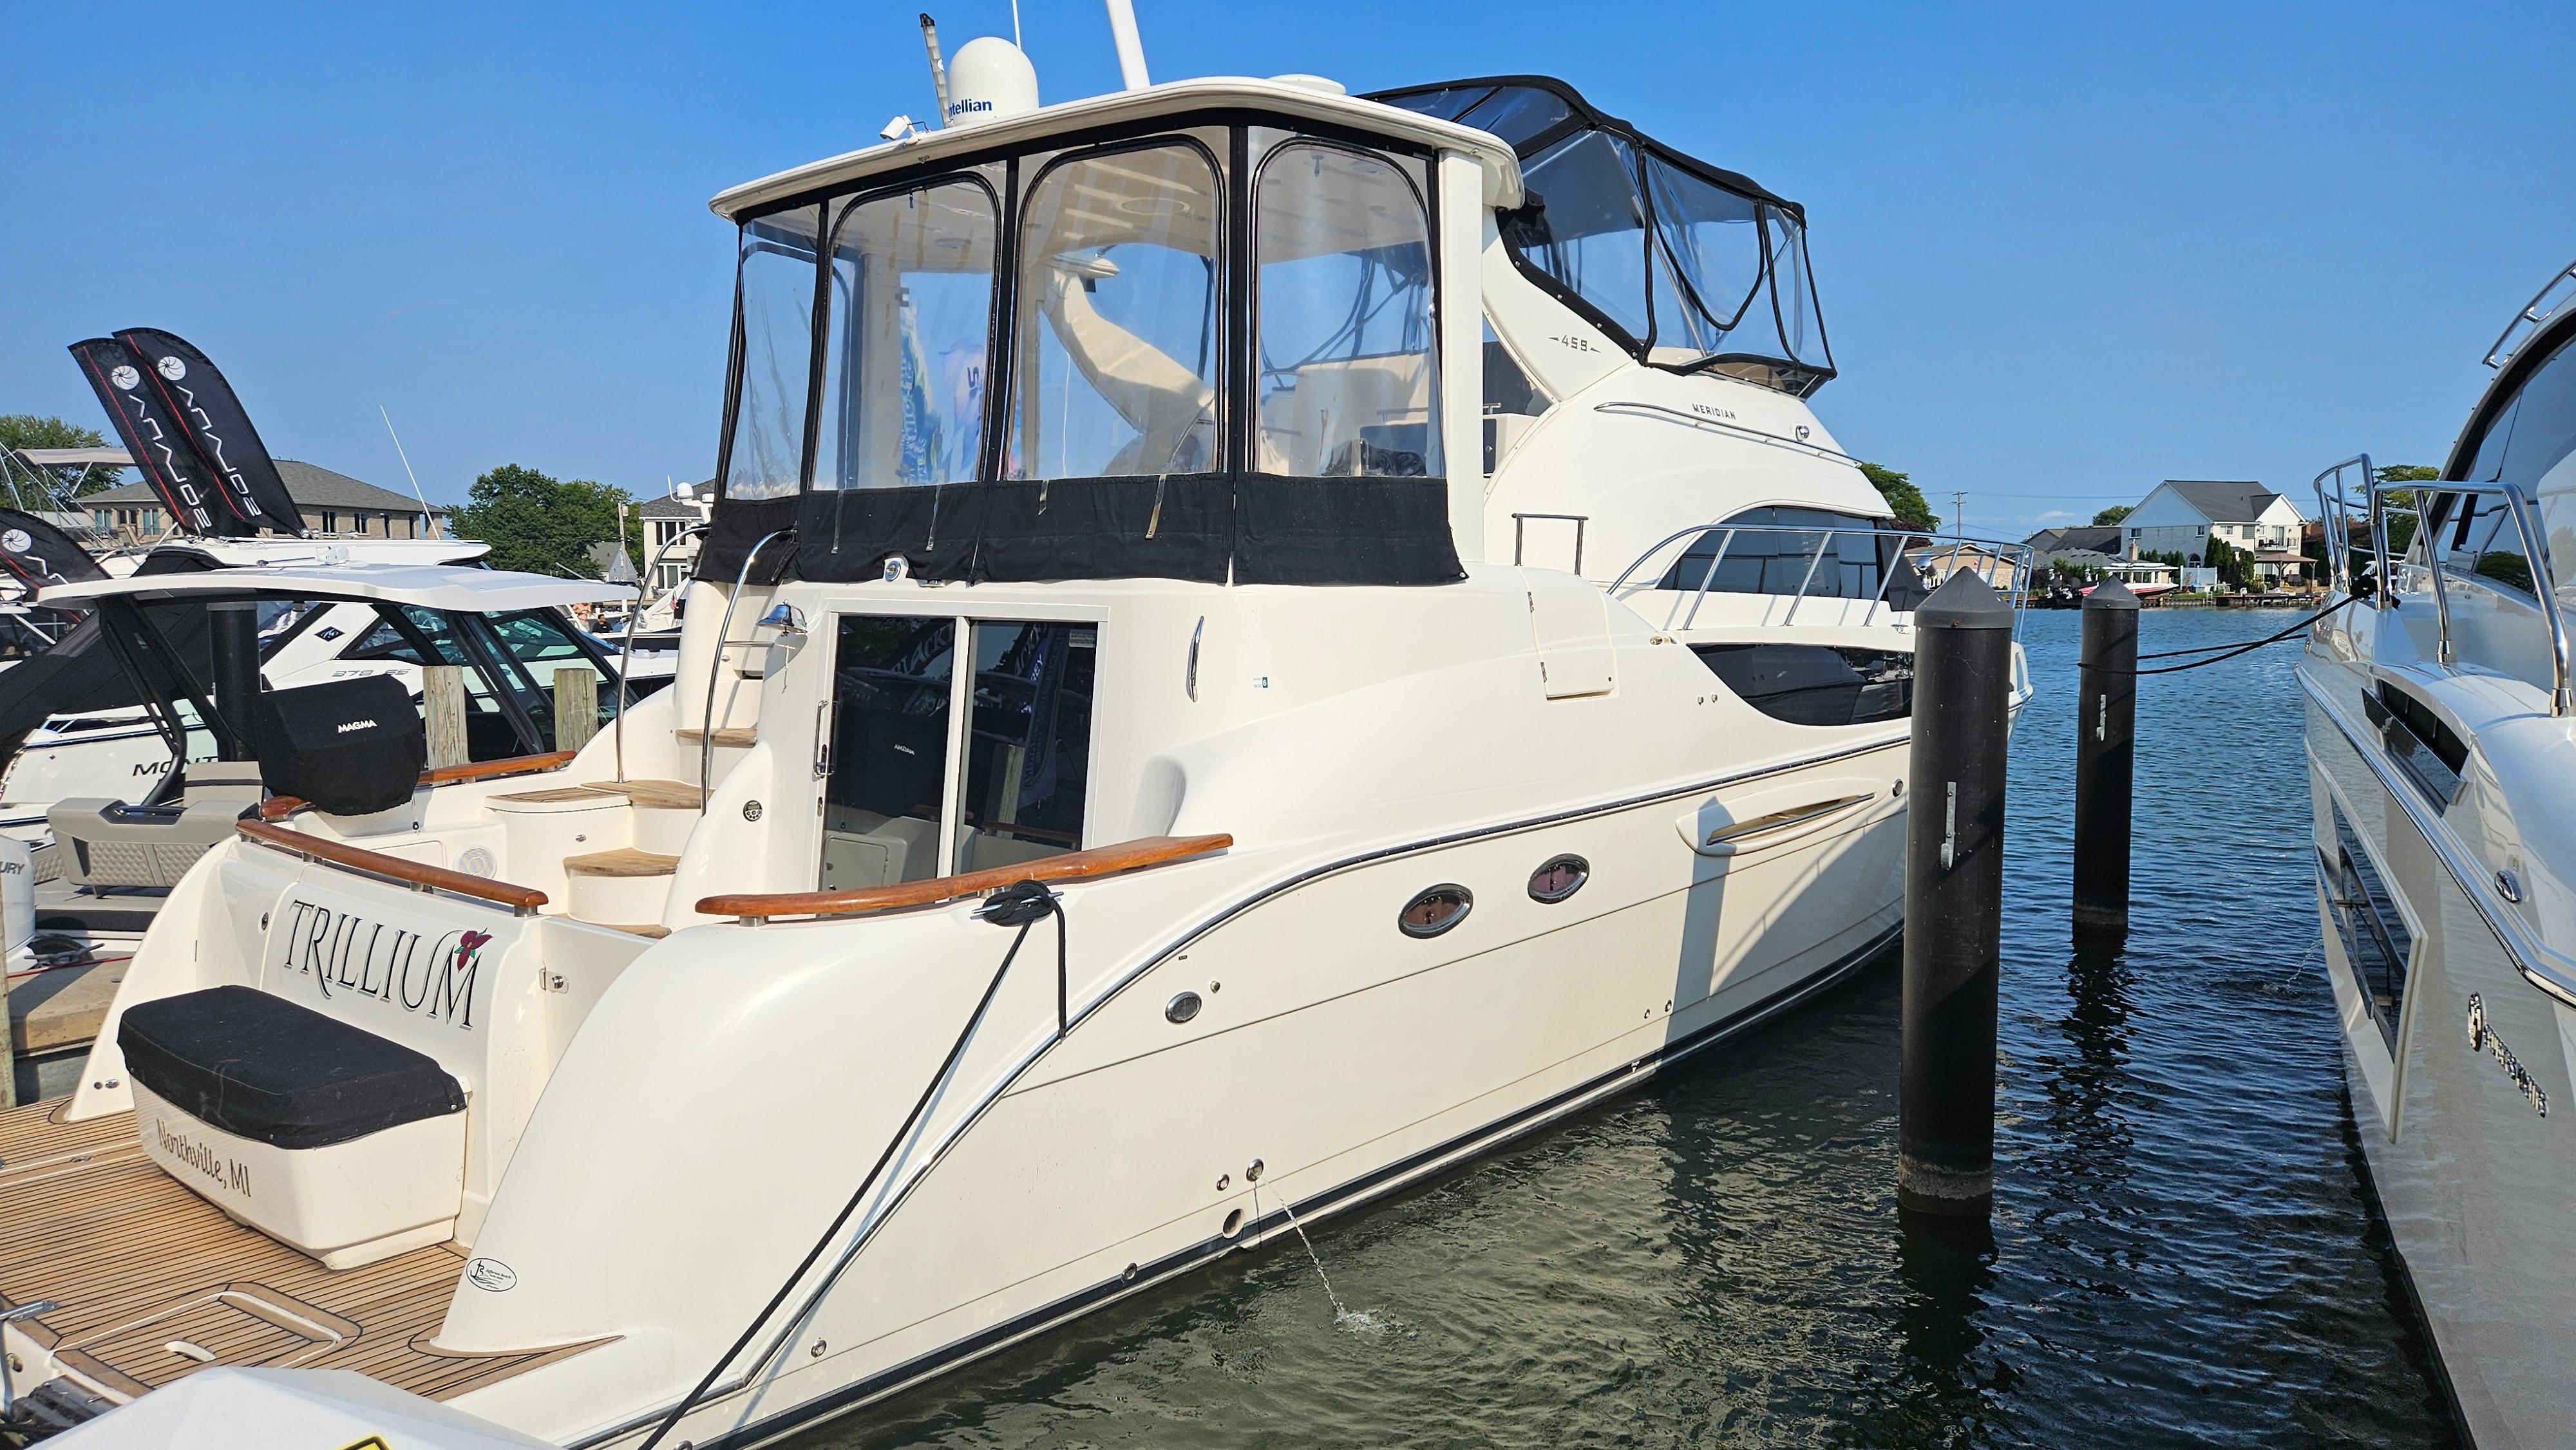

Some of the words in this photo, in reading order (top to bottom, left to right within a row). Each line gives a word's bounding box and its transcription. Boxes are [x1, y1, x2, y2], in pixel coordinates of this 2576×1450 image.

[1561, 334, 1587, 352] 459
[1692, 403, 1736, 420] MERIDIAN
[337, 719, 378, 733] MAGMA
[283, 899, 482, 1031] TRILLIUM
[156, 1118, 227, 1189] Northville,
[230, 1158, 251, 1198] MI
